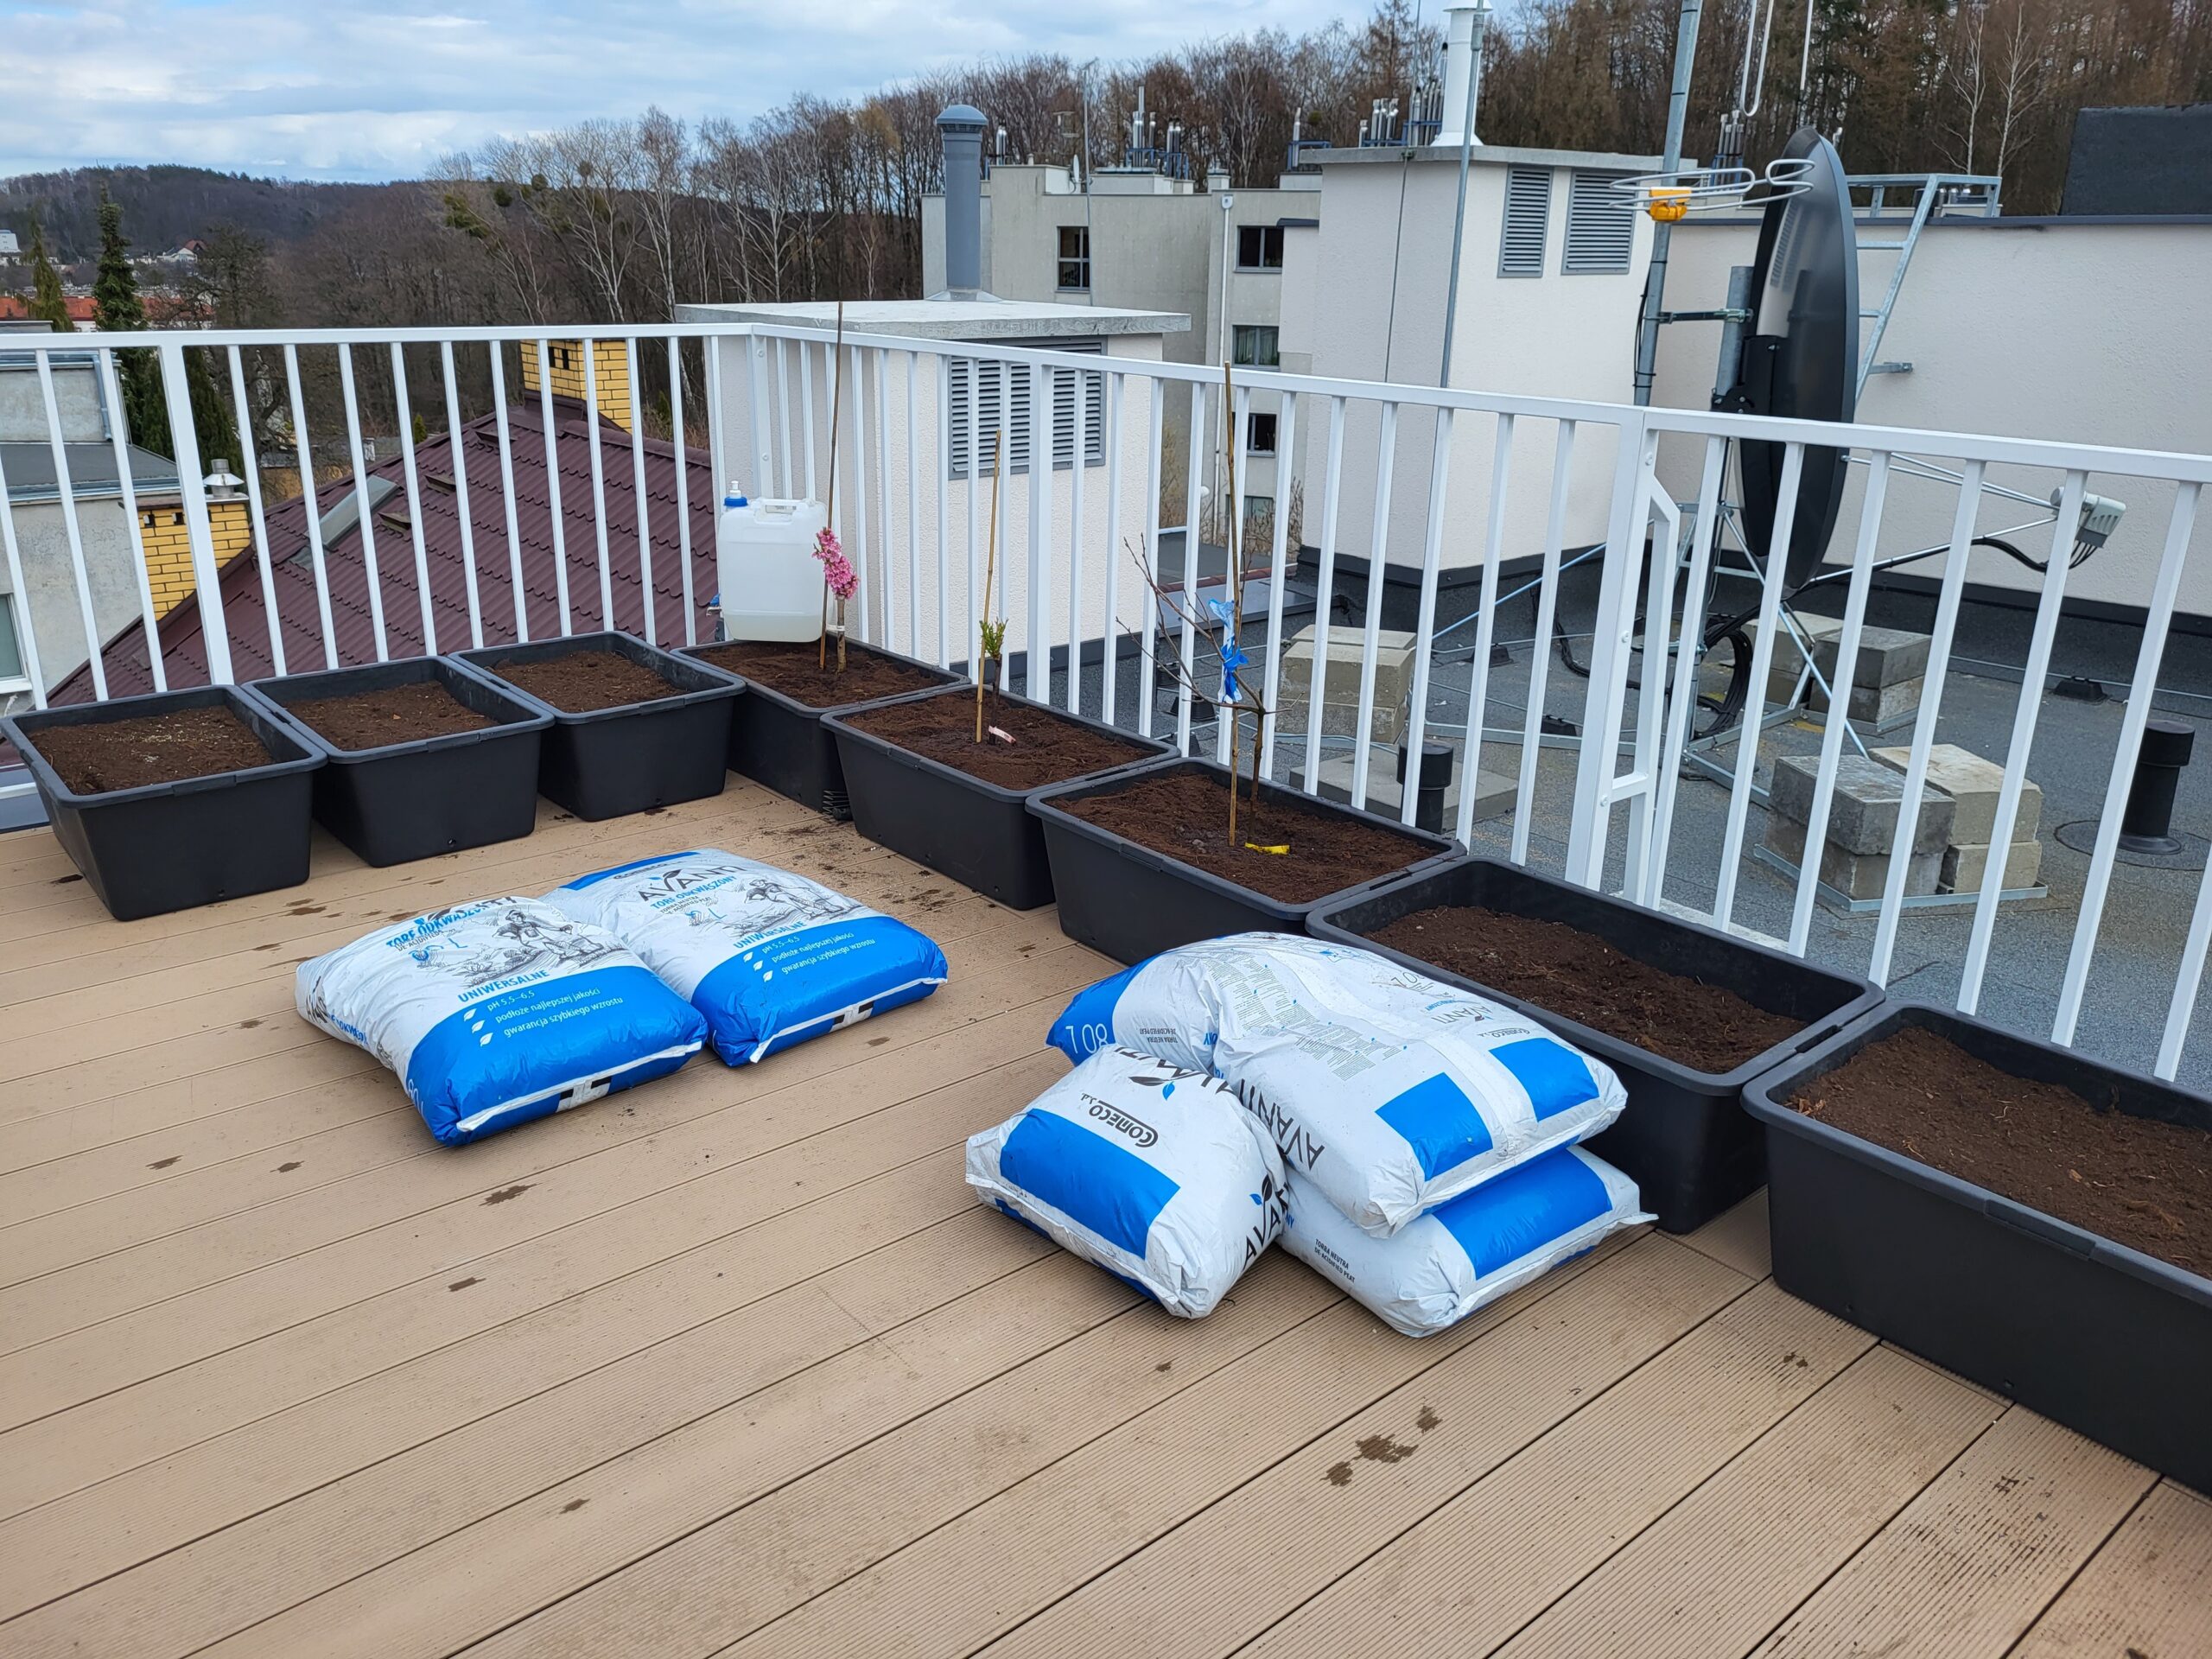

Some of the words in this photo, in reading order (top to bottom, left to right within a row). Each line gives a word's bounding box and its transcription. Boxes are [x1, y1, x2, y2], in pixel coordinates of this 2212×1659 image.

[638, 865, 747, 902] AVANTI
[650, 897, 676, 909] TORF
[733, 920, 807, 949] UNIWERSALNE
[798, 938, 834, 956] najlepszej
[833, 931, 855, 946] jakości
[761, 944, 773, 955] pH
[781, 957, 818, 975] gwarancja
[817, 945, 850, 962] szybkiego
[849, 938, 876, 950] wzrostu
[457, 969, 550, 1003] UNIWERSALNE
[486, 1001, 500, 1013] pH
[530, 995, 573, 1014] najlepszej
[572, 987, 601, 1002] jakości
[503, 1018, 549, 1038] gwarancja
[549, 1005, 591, 1024] szybkiego
[590, 996, 624, 1010] wzrostu
[1430, 1006, 1493, 1025] AVANTI
[1089, 1100, 1158, 1148] COMECO
[1315, 1239, 1331, 1255] TORBA
[1331, 1250, 1350, 1270] NEUTRA
[1343, 1271, 1356, 1282] PEAT
